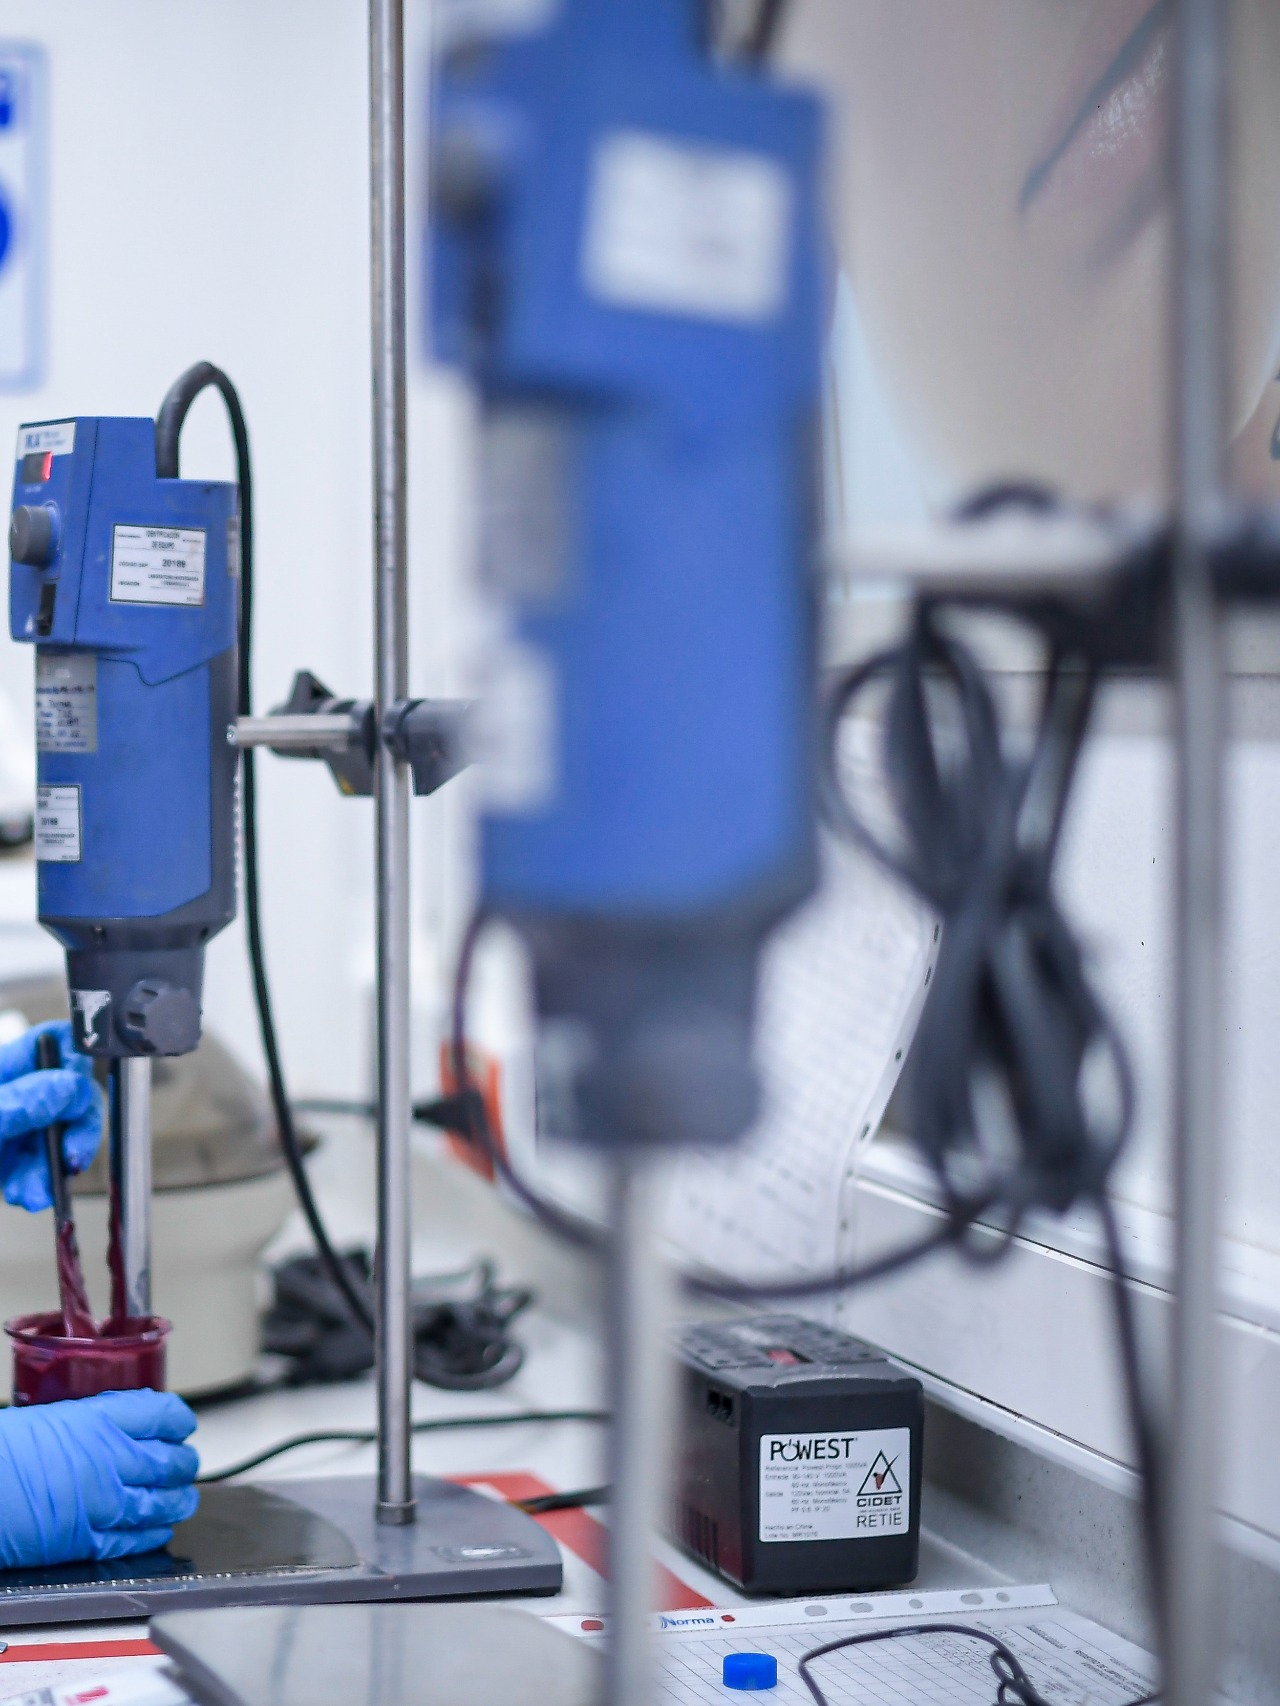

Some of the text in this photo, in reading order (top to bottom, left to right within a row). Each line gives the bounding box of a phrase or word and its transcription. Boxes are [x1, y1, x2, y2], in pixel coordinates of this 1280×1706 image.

[770, 1438, 855, 1461] POWEST
[856, 1496, 902, 1507] CIDET
[856, 1512, 902, 1528] RETIE
[660, 1616, 714, 1629] Norma
